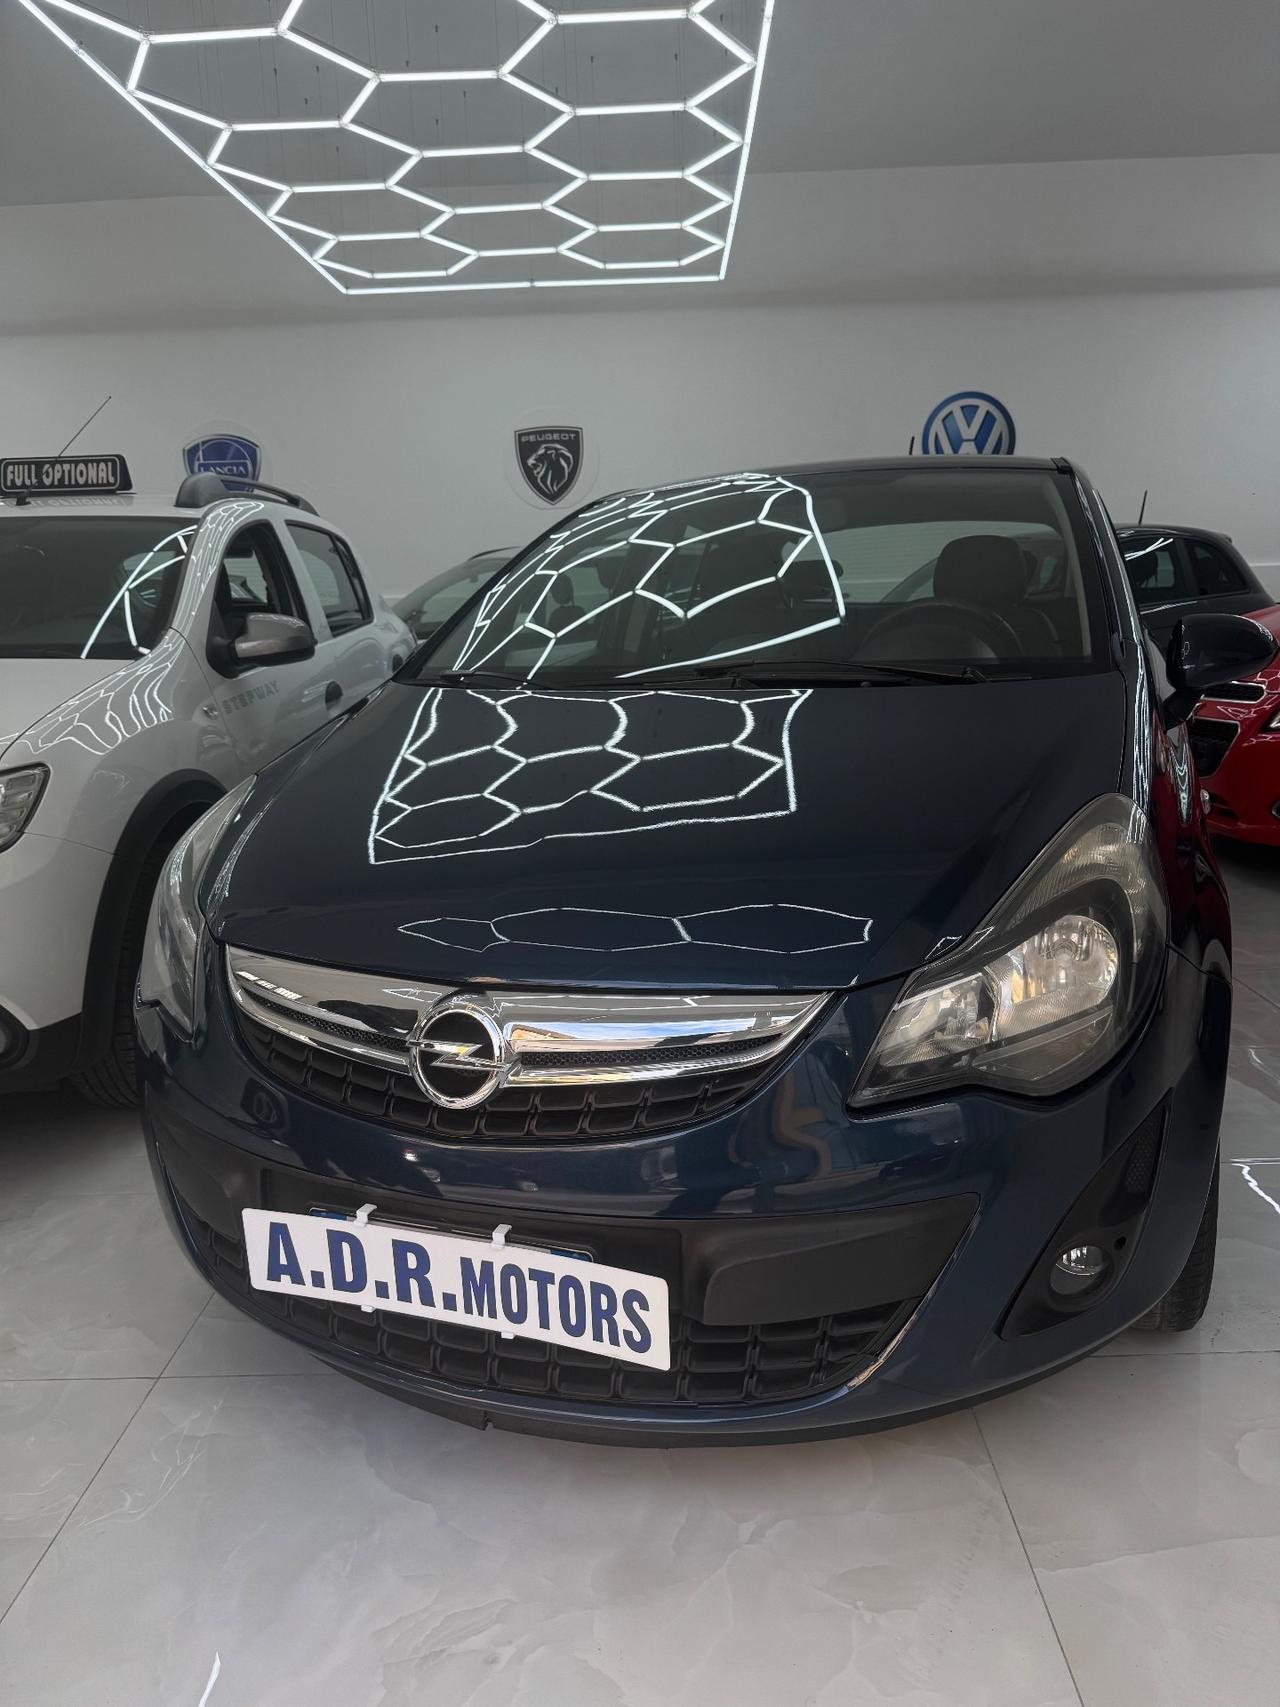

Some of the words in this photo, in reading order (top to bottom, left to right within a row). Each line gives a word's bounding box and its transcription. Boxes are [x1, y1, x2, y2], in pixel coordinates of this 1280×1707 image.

[521, 433, 576, 442] PEUGEOT
[6, 464, 39, 487] FULL
[42, 461, 115, 486] OPTIONAL
[200, 465, 247, 475] LANCIA
[222, 680, 279, 714] STEPWAY
